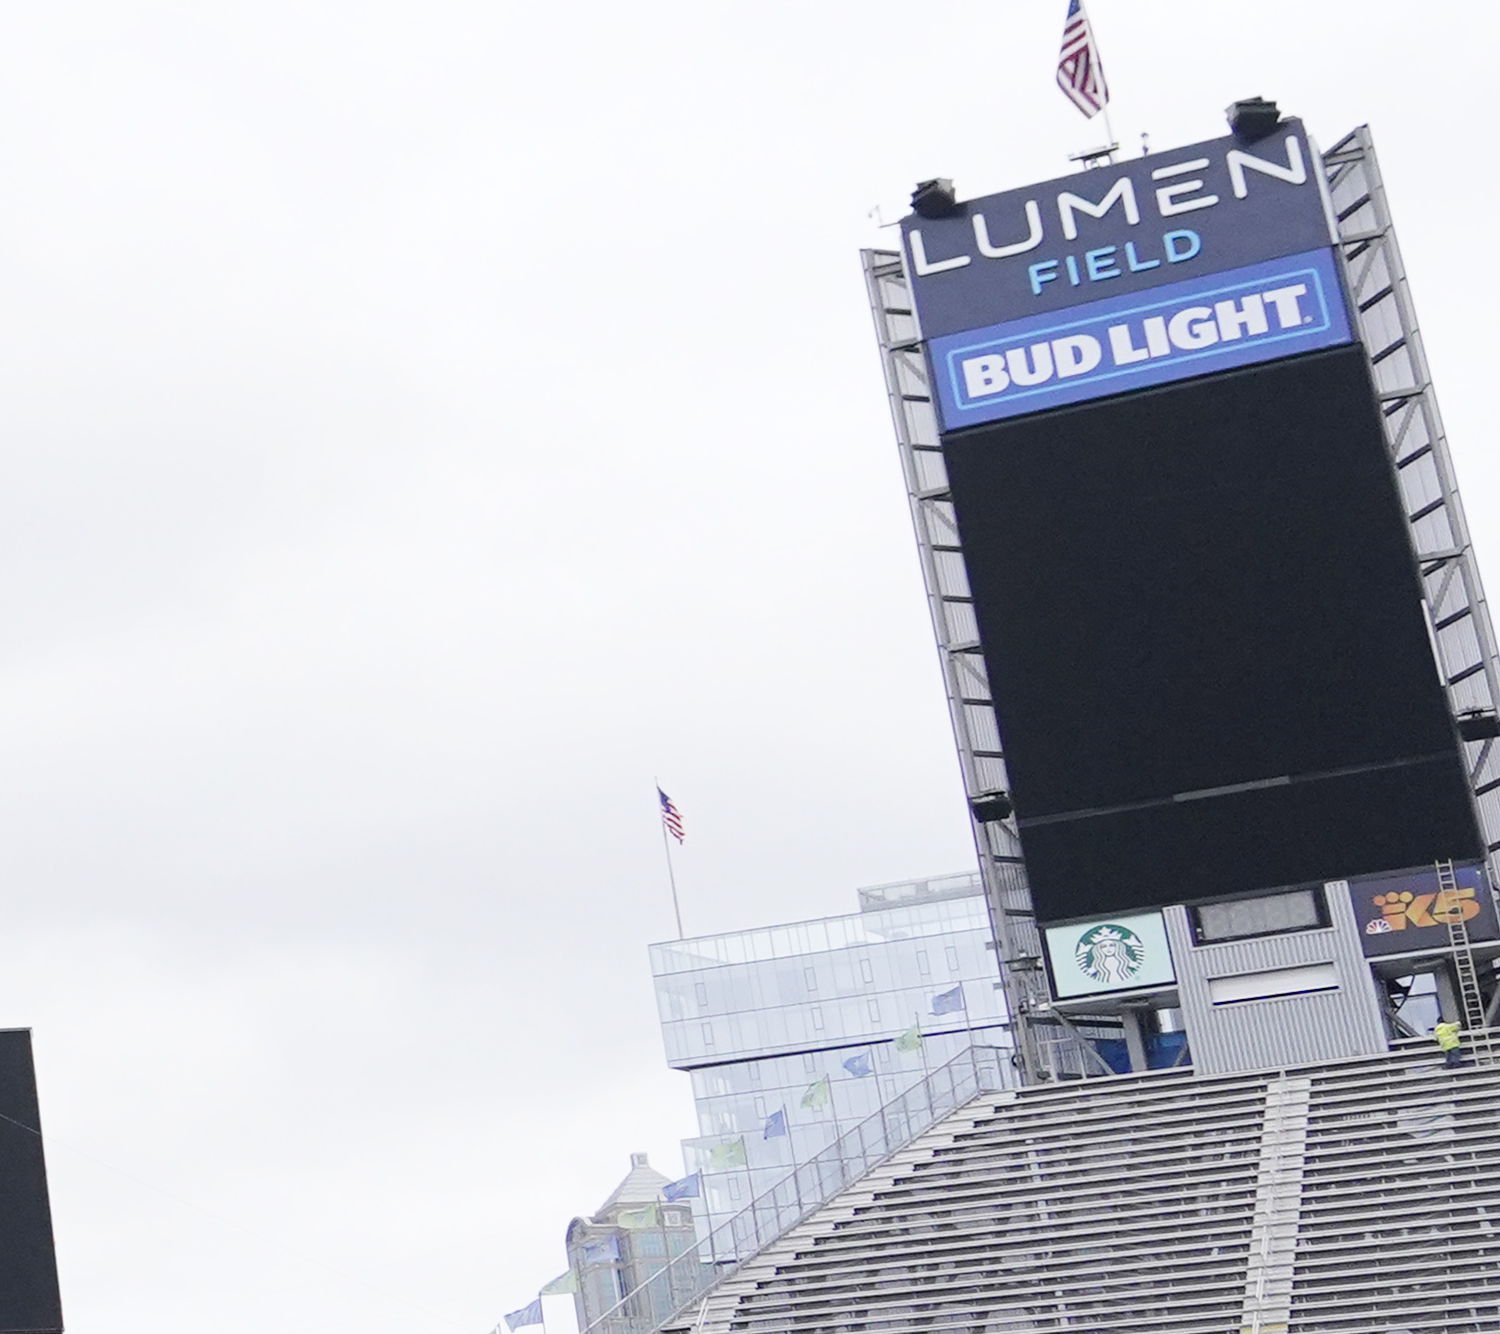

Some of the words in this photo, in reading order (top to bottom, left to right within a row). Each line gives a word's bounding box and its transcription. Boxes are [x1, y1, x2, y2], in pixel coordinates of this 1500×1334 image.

[908, 134, 1311, 278] LUMEN
[1027, 227, 1204, 296] FIELD
[961, 337, 1104, 401] BUD
[1109, 281, 1310, 368] LIGHT
